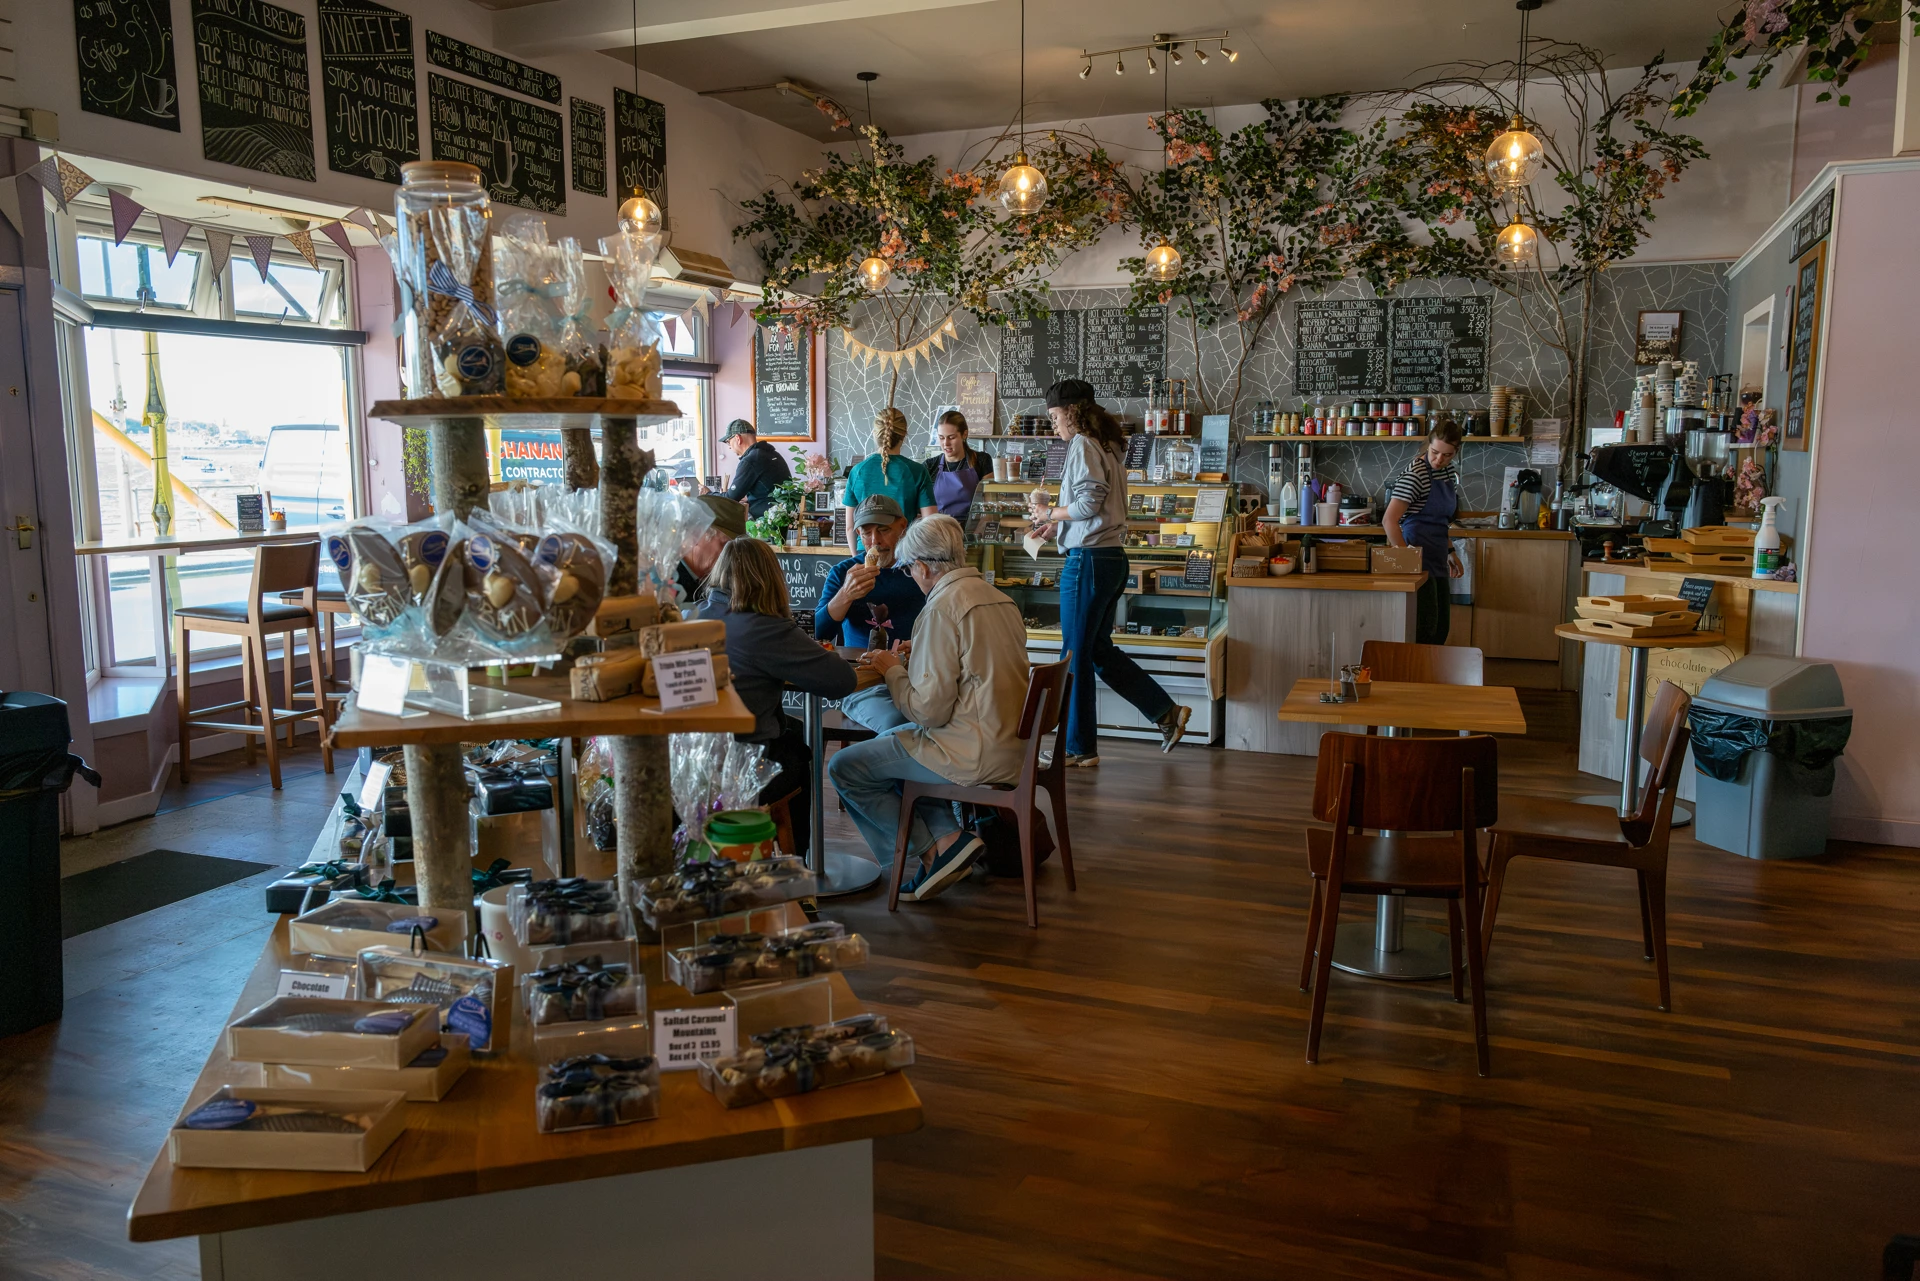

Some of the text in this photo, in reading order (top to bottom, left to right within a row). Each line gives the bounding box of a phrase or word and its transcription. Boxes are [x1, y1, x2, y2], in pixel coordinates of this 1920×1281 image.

[99, 1, 117, 28] my
[248, 2, 259, 24] A
[263, 7, 305, 38] BREW?
[322, 14, 409, 54] WAFFLE
[80, 36, 130, 73] Coffee
[198, 23, 308, 72] OUR TEA COMES FROM
[430, 34, 544, 84] WE USE SHORTBREAD AND TABLET
[198, 42, 222, 65] TLC
[226, 51, 246, 72] WHO
[247, 57, 280, 84] SOURCE
[375, 62, 415, 82] A WEEK
[432, 48, 544, 98] MADE BY SMALL SCOTTISH SUPPLIERS
[199, 65, 311, 112] HIGH ELEVATION TEAS FROM
[327, 66, 415, 109] STOPS YOU FEELING
[430, 74, 496, 113] OUR COFFEE BEANS
[262, 101, 311, 129] PLANTATIONS
[335, 93, 420, 155] ANTIQUE
[510, 99, 560, 130] 100% Arabica
[433, 128, 493, 154] EVERY WEEK BY SMALL
[517, 120, 557, 143] CHOCOLATEY
[440, 143, 491, 169] SCOTTISH COMPANY
[540, 144, 562, 163] SWEET
[623, 159, 661, 191] BAKED
[1395, 330, 1414, 339] WHITE
[1003, 365, 1025, 373] MOCHA
[763, 382, 800, 394] HOT BROWNIE
[501, 441, 563, 460] HANAN
[785, 573, 808, 585] OWAY
[790, 586, 816, 598] CREAM
[1660, 656, 1707, 673] chocolate
[291, 980, 330, 993] Chocolate
[663, 1014, 726, 1026] Salted Caramel
[672, 1027, 717, 1038] Mountains
[669, 1053, 682, 1061] Box
